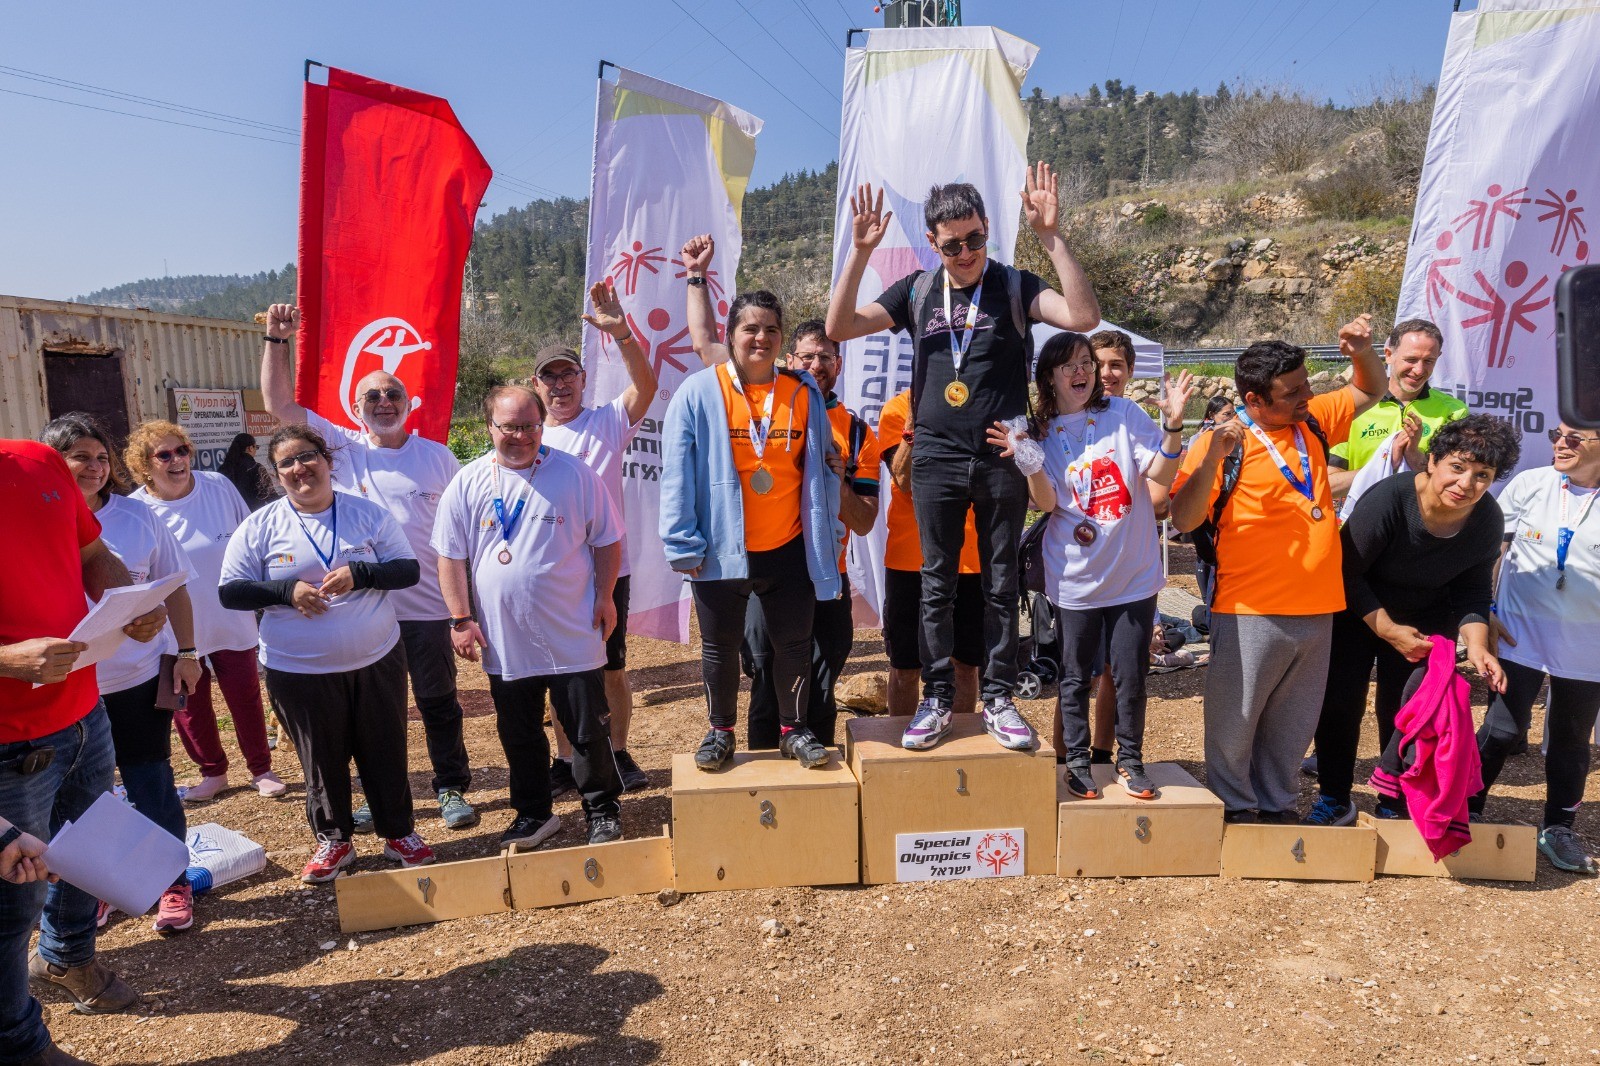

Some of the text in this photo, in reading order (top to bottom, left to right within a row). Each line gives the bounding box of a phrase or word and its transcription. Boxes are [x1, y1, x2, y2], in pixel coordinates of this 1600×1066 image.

[194, 396, 219, 409] תפעולי
[194, 410, 239, 419] OPERATIONAL AREA
[1368, 428, 1389, 437] אקים
[956, 768, 966, 793] 1
[759, 799, 774, 825] 2
[1134, 816, 1149, 839] 3
[914, 837, 971, 850] Special
[1291, 837, 1306, 863] 4
[900, 851, 971, 864] Olympics
[584, 857, 599, 882] 6
[930, 865, 971, 877] ישראל
[417, 876, 431, 903] 7
